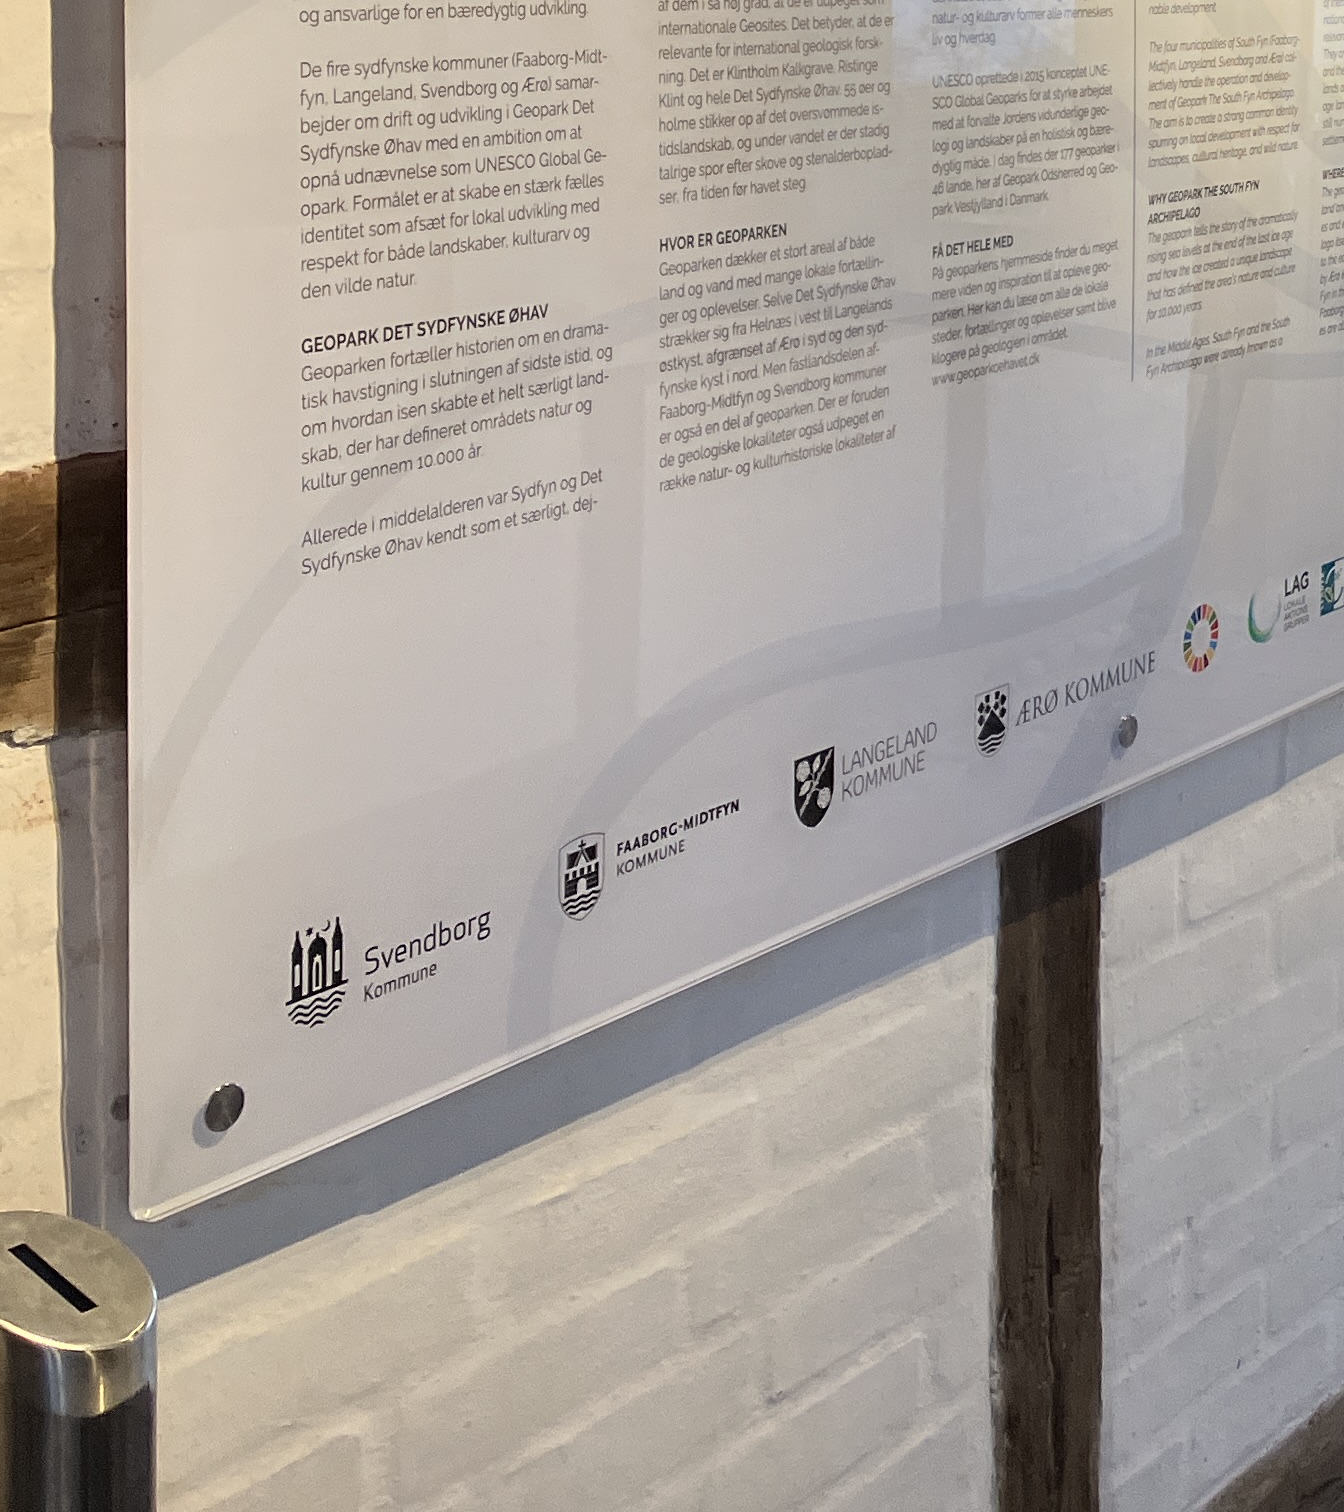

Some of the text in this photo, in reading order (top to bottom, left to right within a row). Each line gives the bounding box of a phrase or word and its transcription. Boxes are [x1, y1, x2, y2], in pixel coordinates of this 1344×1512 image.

[1148, 179, 1260, 205] WHY GEOPARK THE SOUTH FYN
[1147, 205, 1201, 226] ARCHIPELAGO
[659, 223, 787, 253] HVOR ER GEOPARKEN
[932, 234, 1014, 259] FÅ DET HELE MED
[301, 303, 549, 354] GEOPARK DET SYDFYNSKE ØHAV
[1284, 571, 1309, 597] LAG
[1015, 650, 1155, 727] ÆRØ KOMMUNE
[842, 721, 938, 777] LANGELAND
[841, 749, 926, 802] KOMMUNE
[616, 799, 739, 857] FAABORG-MIDTFYN
[616, 838, 685, 876] KOMMUNE
[364, 911, 491, 976] Svendborg
[363, 963, 437, 1003] Kommune
